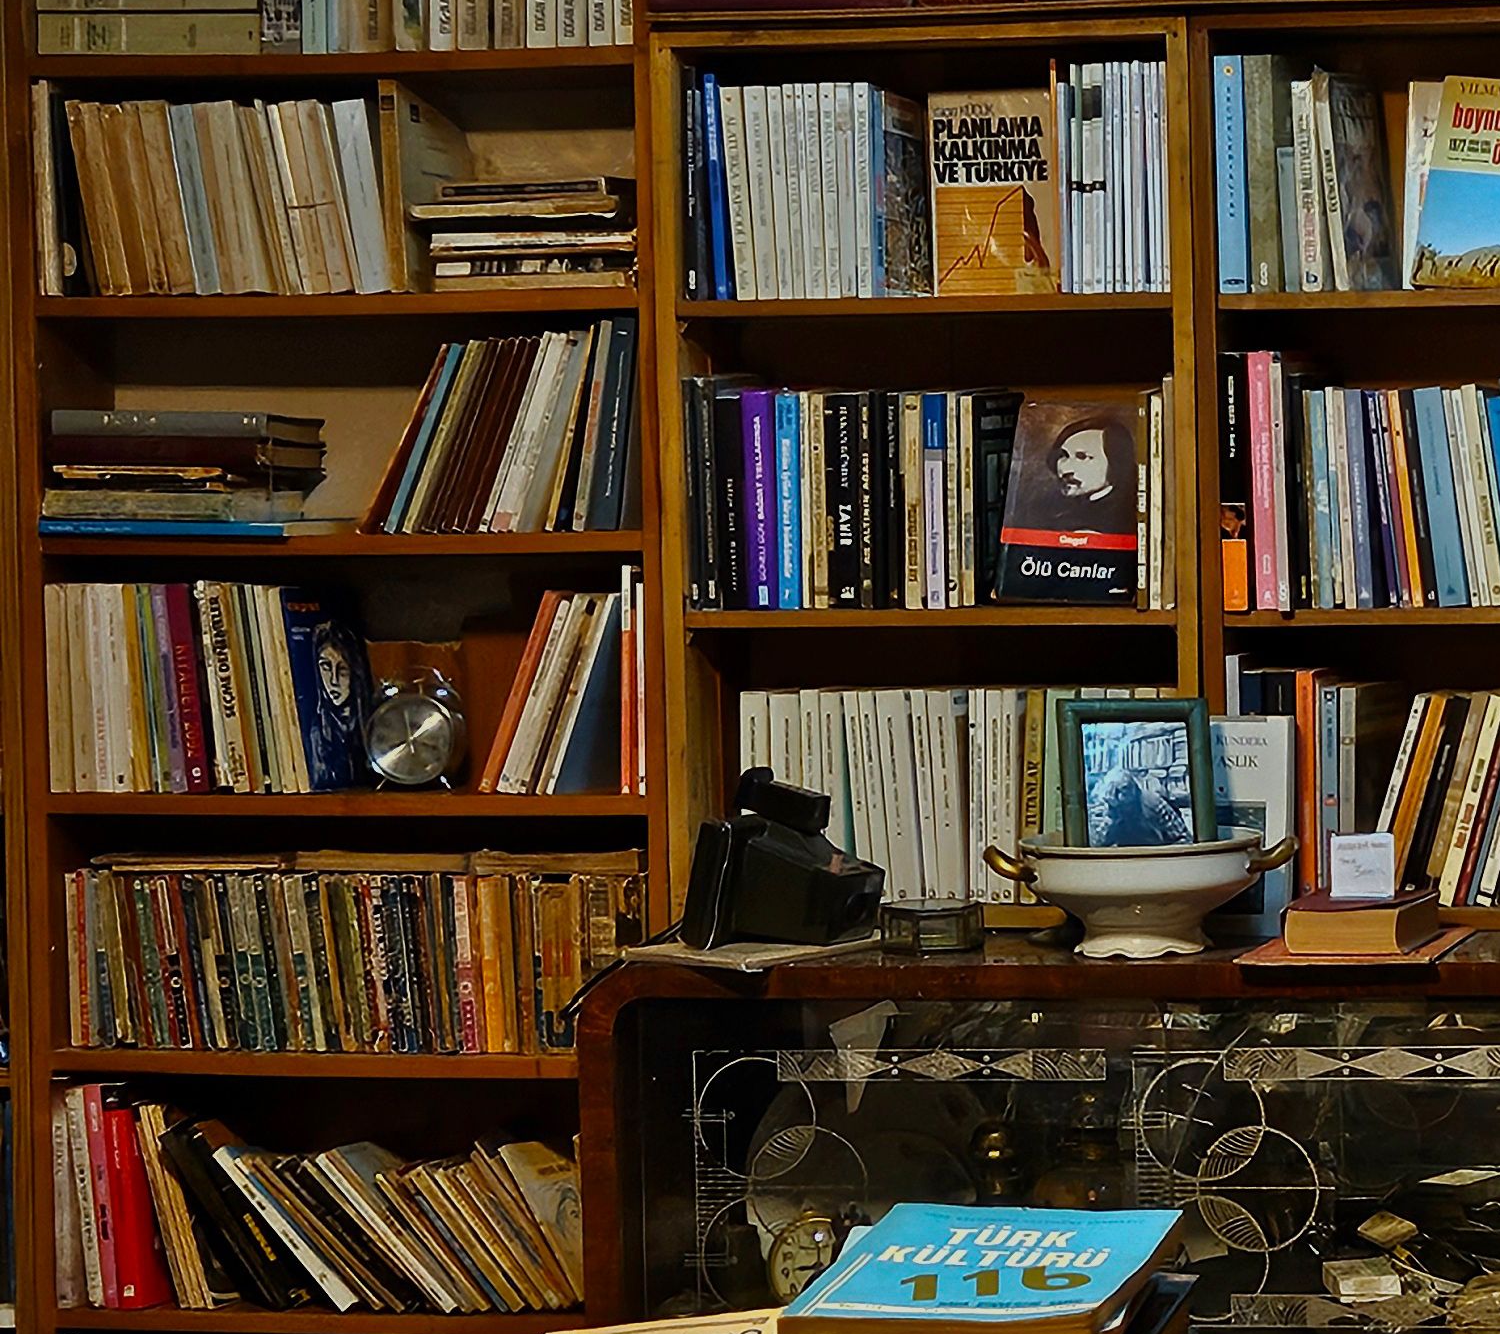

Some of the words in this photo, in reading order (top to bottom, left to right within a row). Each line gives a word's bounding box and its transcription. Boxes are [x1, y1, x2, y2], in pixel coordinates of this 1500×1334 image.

[932, 116, 1043, 140] PLANLAMA
[933, 138, 1042, 161] KALKINMA
[933, 162, 960, 183] VE
[1020, 555, 1053, 577] Ölü
[1056, 560, 1118, 580] Canlar
[1215, 733, 1268, 747] KUNDERA
[1216, 754, 1259, 770] AŞLIK
[947, 1224, 1078, 1248] TÜRK
[876, 1243, 1112, 1268] KÜLTÜRÜ
[899, 1265, 1092, 1302] 116
